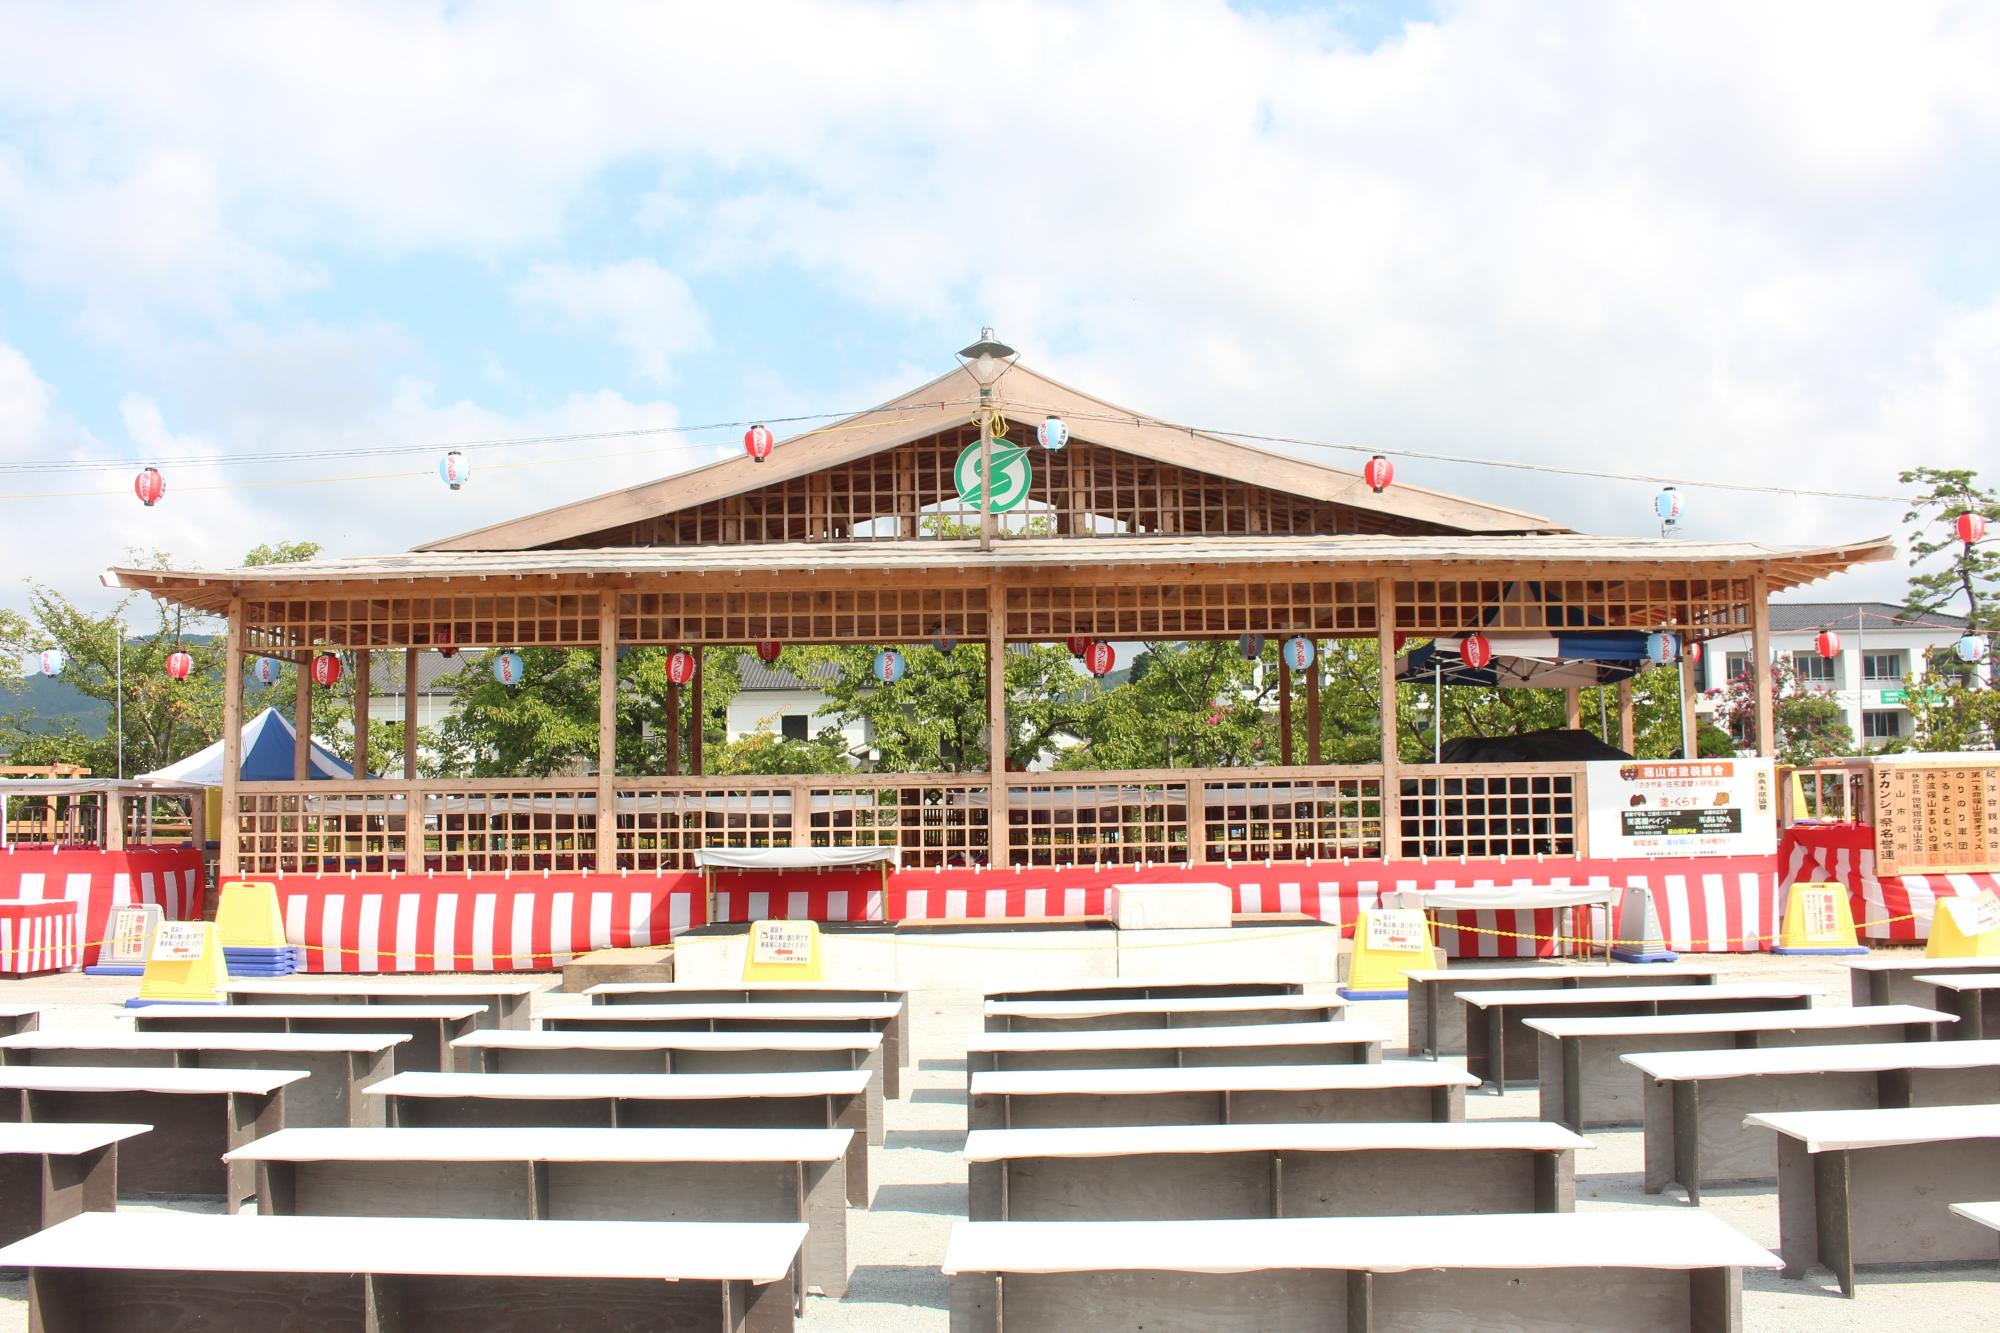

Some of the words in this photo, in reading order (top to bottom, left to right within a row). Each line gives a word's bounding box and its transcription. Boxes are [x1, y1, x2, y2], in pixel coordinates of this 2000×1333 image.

[1643, 766, 1724, 778] 篠山市塗装組合
[1895, 772, 1907, 851] 篠山市役所
[1956, 771, 1968, 850] のりのり軍団
[1878, 769, 1895, 860] デカンショ祭名誉連
[1926, 773, 1939, 852] 丹波篠山まるいの連
